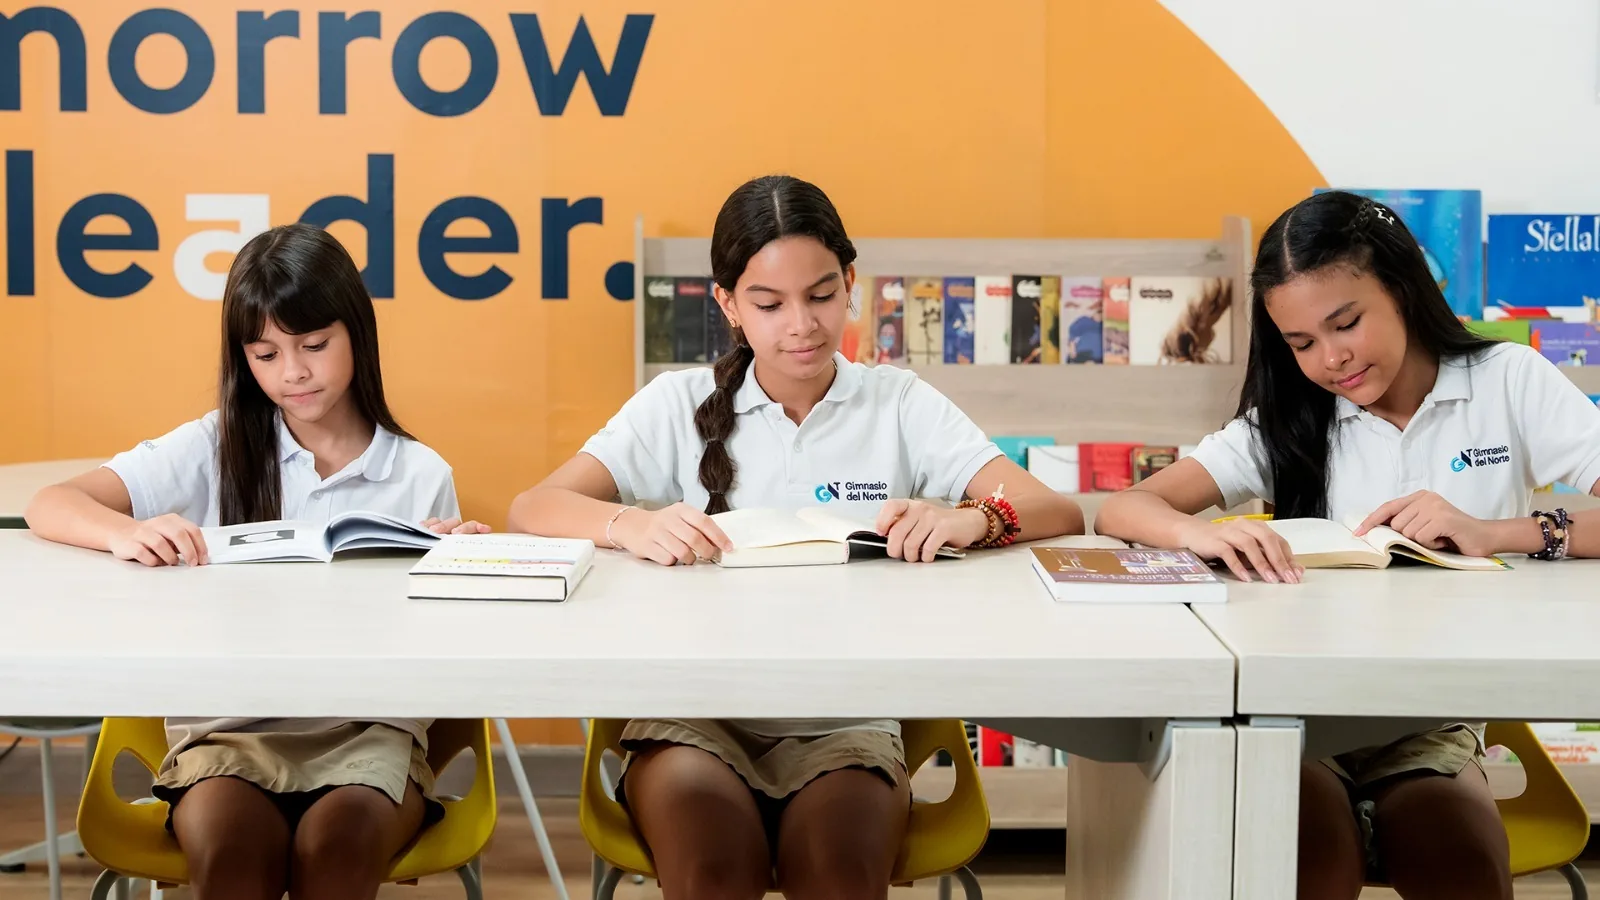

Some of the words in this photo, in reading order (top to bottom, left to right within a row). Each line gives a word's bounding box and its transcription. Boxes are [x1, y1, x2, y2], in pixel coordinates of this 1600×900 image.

[1524, 215, 1600, 253] Stellal
[1473, 445, 1509, 457] Gimnasio
[1475, 457, 1487, 467] del
[1488, 455, 1510, 465] Norte
[845, 481, 887, 490] Gimnasio
[846, 491, 861, 501] del
[862, 491, 888, 501] Norte
